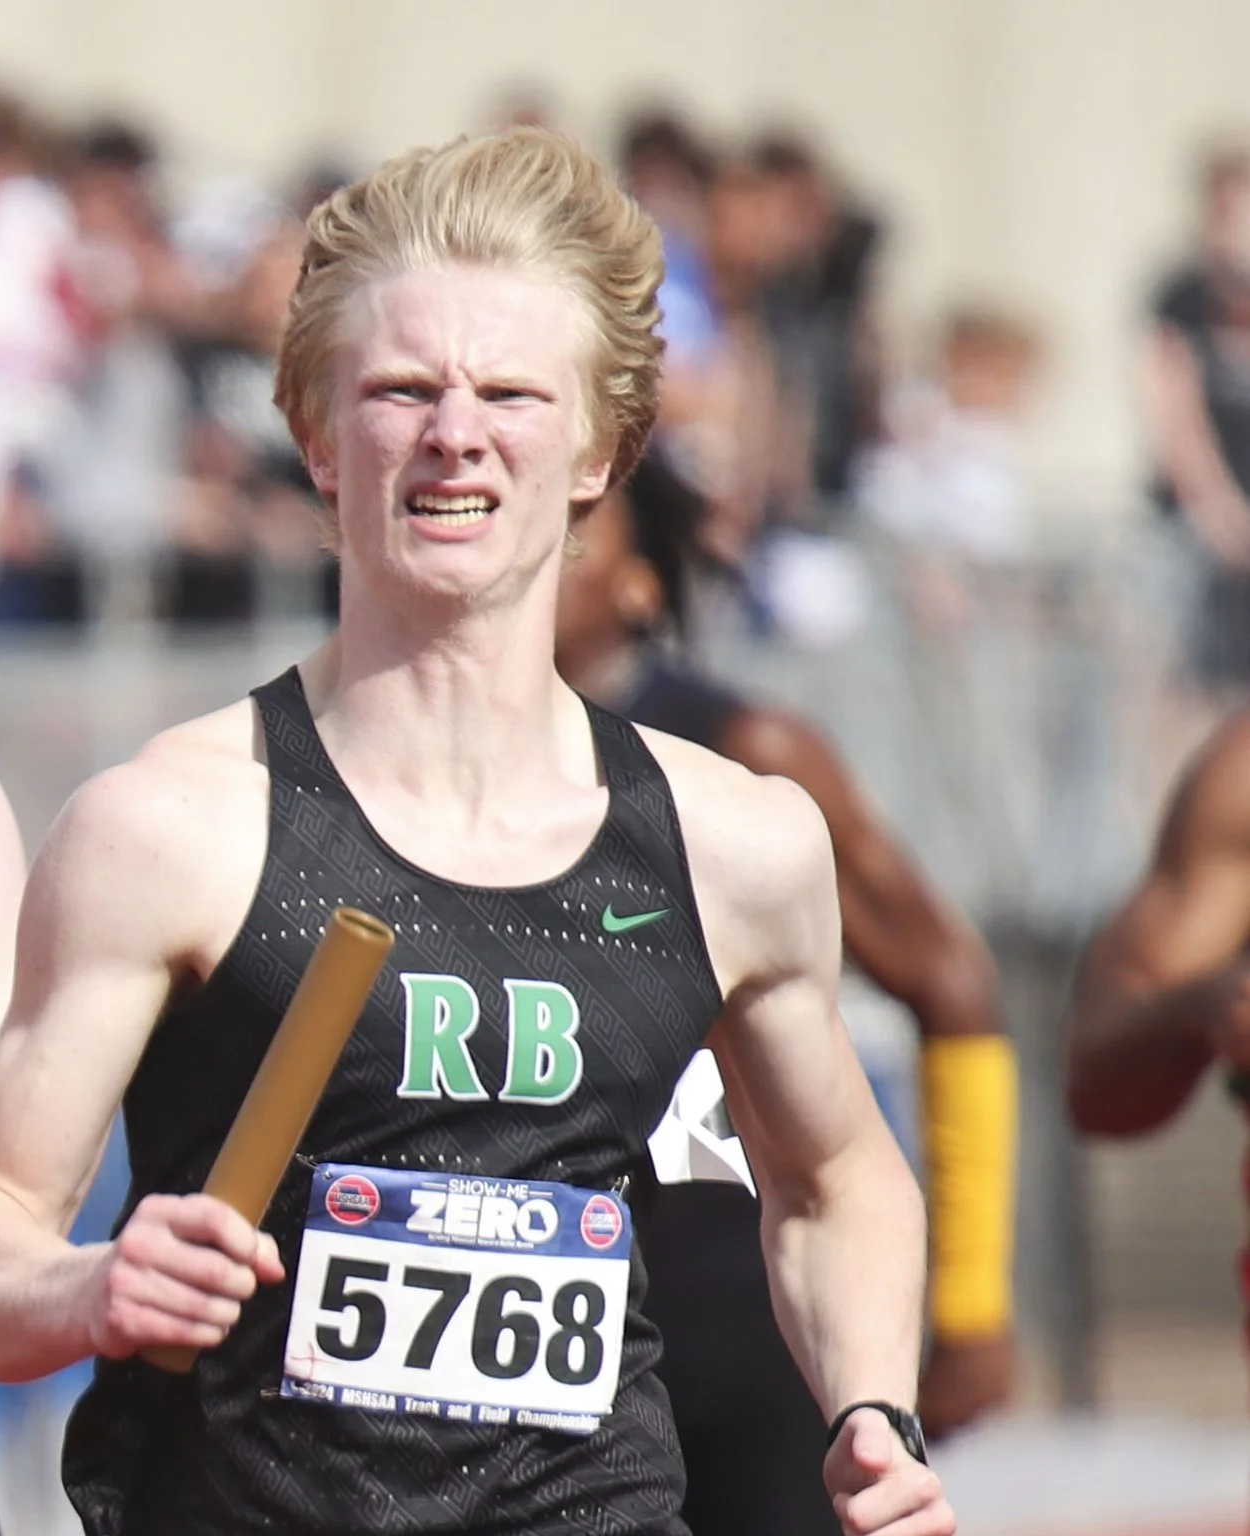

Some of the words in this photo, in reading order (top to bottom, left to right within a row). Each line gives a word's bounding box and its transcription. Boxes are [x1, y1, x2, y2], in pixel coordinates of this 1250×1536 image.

[397, 973, 583, 1105] RB
[406, 1189, 559, 1244] ZERO
[448, 1178, 530, 1200] SHOW-ME
[315, 1254, 606, 1386] 5768
[341, 1388, 396, 1410] MSHSAA
[405, 1396, 440, 1415] Track
[447, 1403, 472, 1421] and
[478, 1405, 510, 1425] Field
